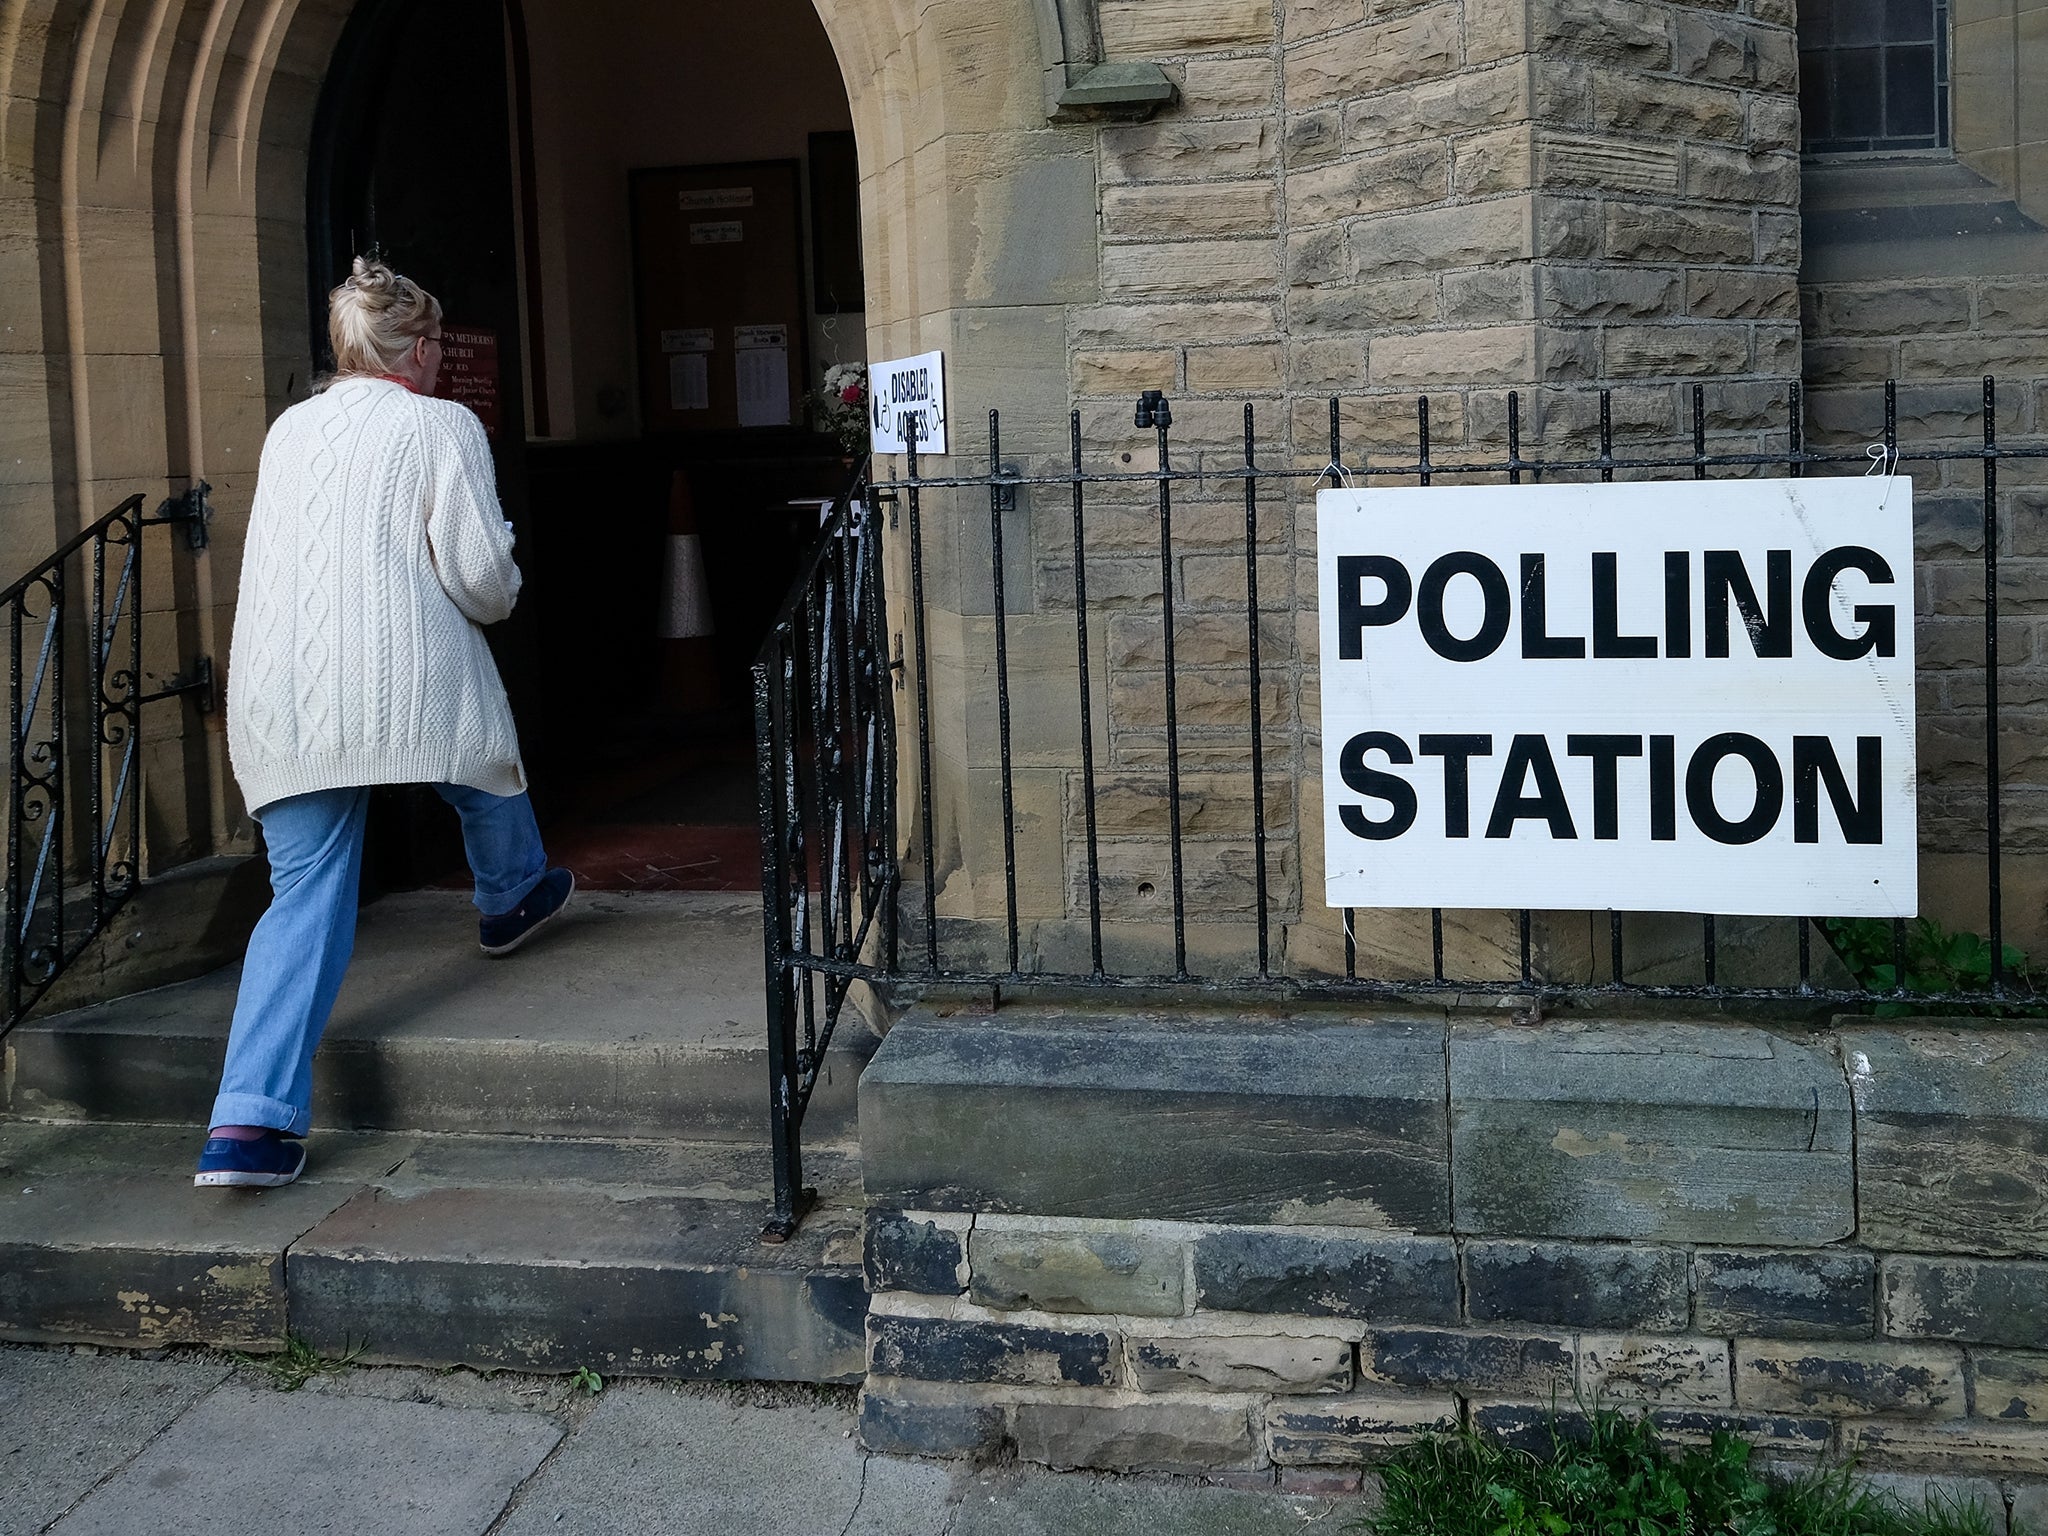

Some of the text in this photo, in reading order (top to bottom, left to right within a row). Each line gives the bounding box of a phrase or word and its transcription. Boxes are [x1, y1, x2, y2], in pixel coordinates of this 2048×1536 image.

[443, 346, 474, 358] CHURCH
[456, 333, 494, 345] METHODIST
[892, 368, 928, 403] DISABLED
[897, 409, 929, 442] ACESS
[1337, 546, 1896, 662] POLLING
[1339, 731, 1883, 845] STATION
